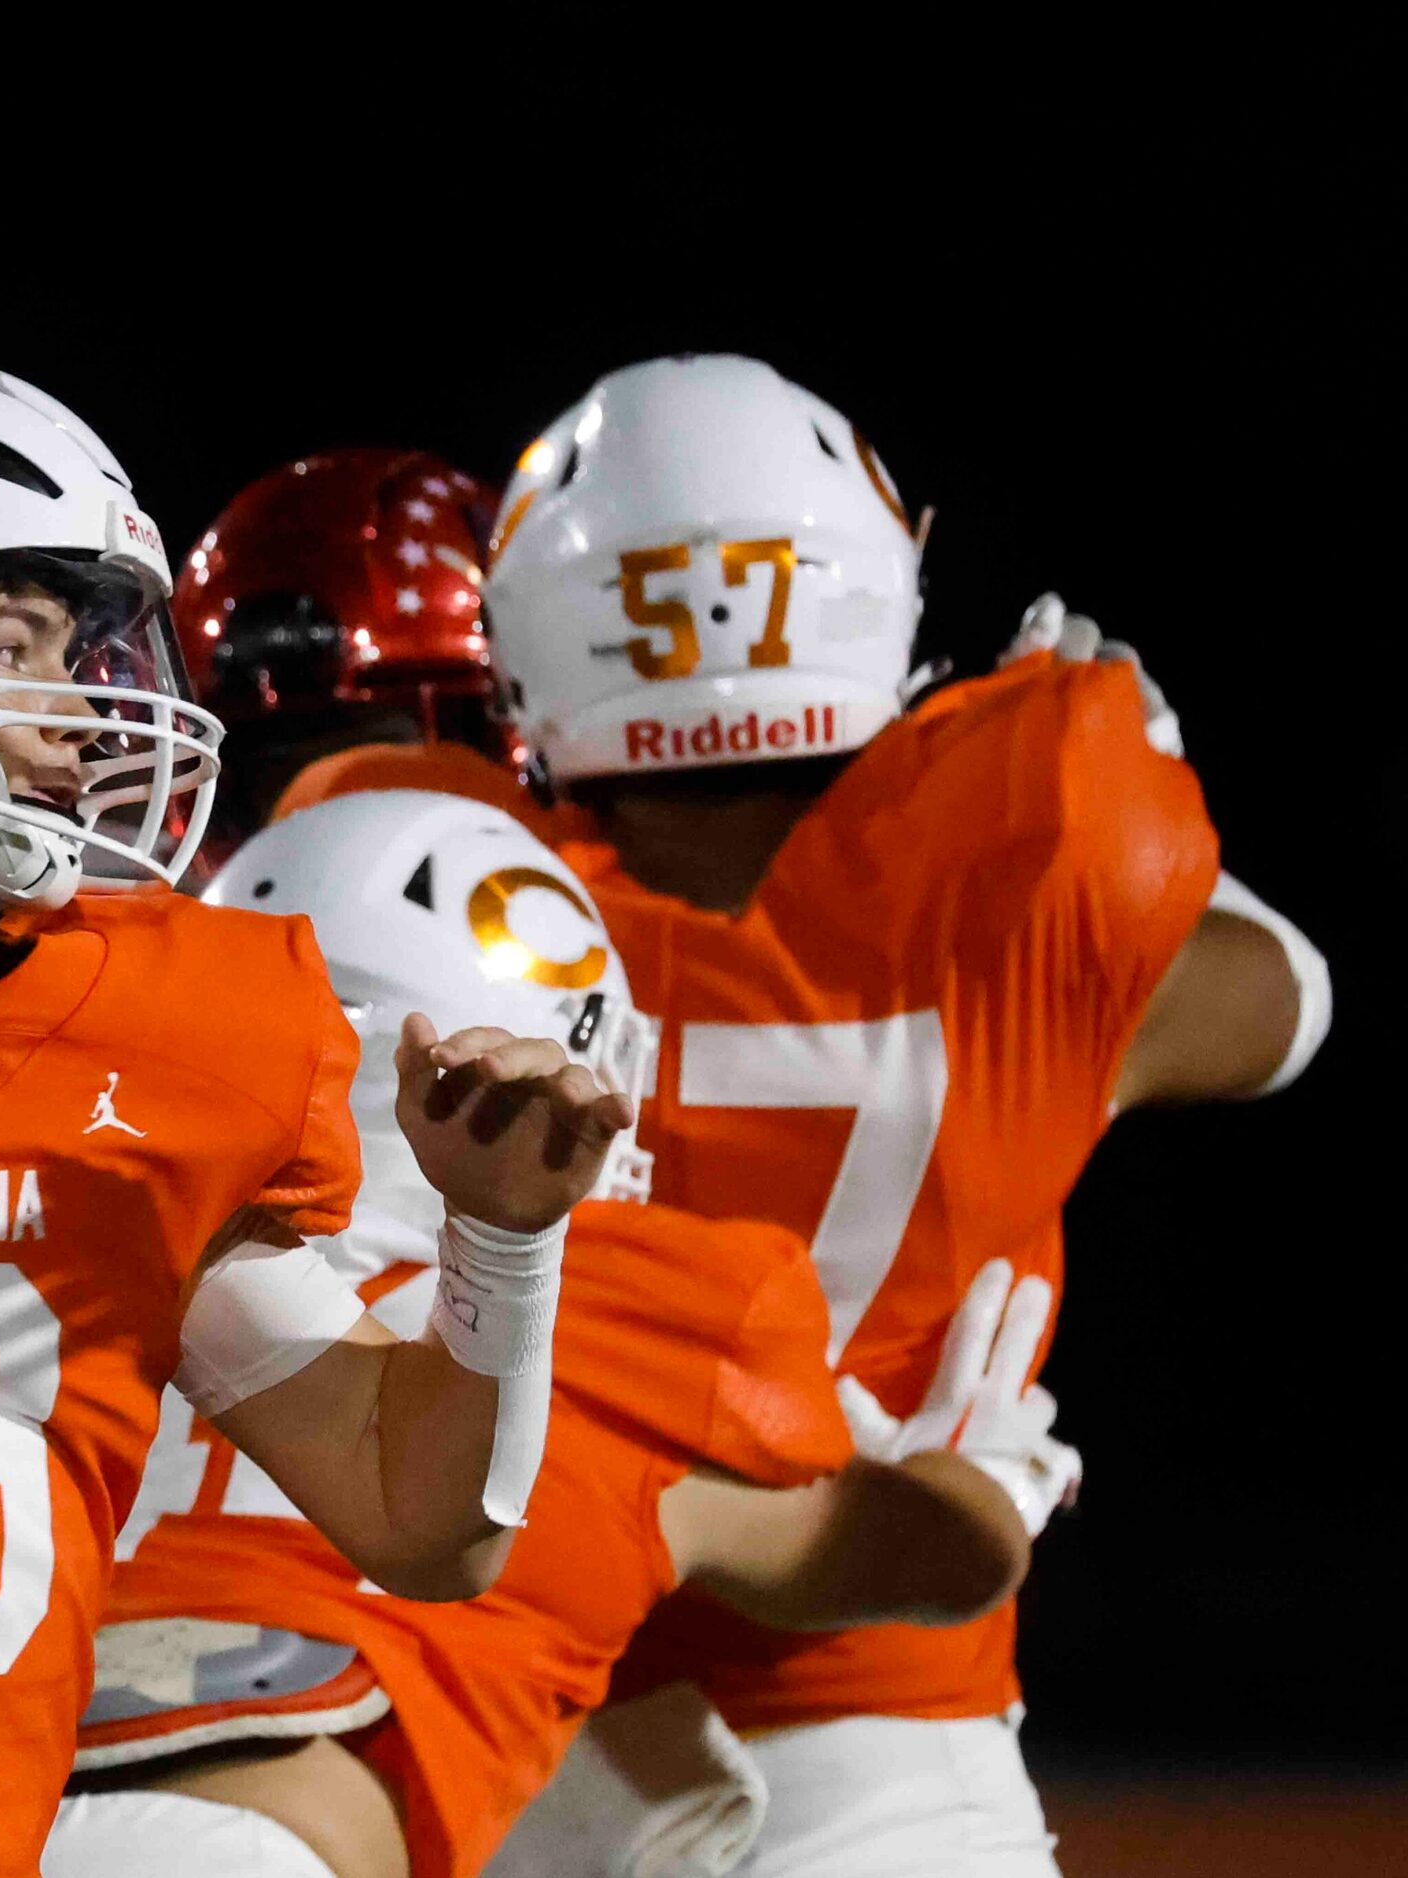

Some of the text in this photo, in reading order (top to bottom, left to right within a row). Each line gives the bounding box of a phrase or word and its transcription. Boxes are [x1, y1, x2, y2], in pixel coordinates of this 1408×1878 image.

[619, 537, 796, 681] 57
[624, 706, 835, 762] Riddell
[467, 867, 609, 990] C
[643, 1009, 949, 1370] 7
